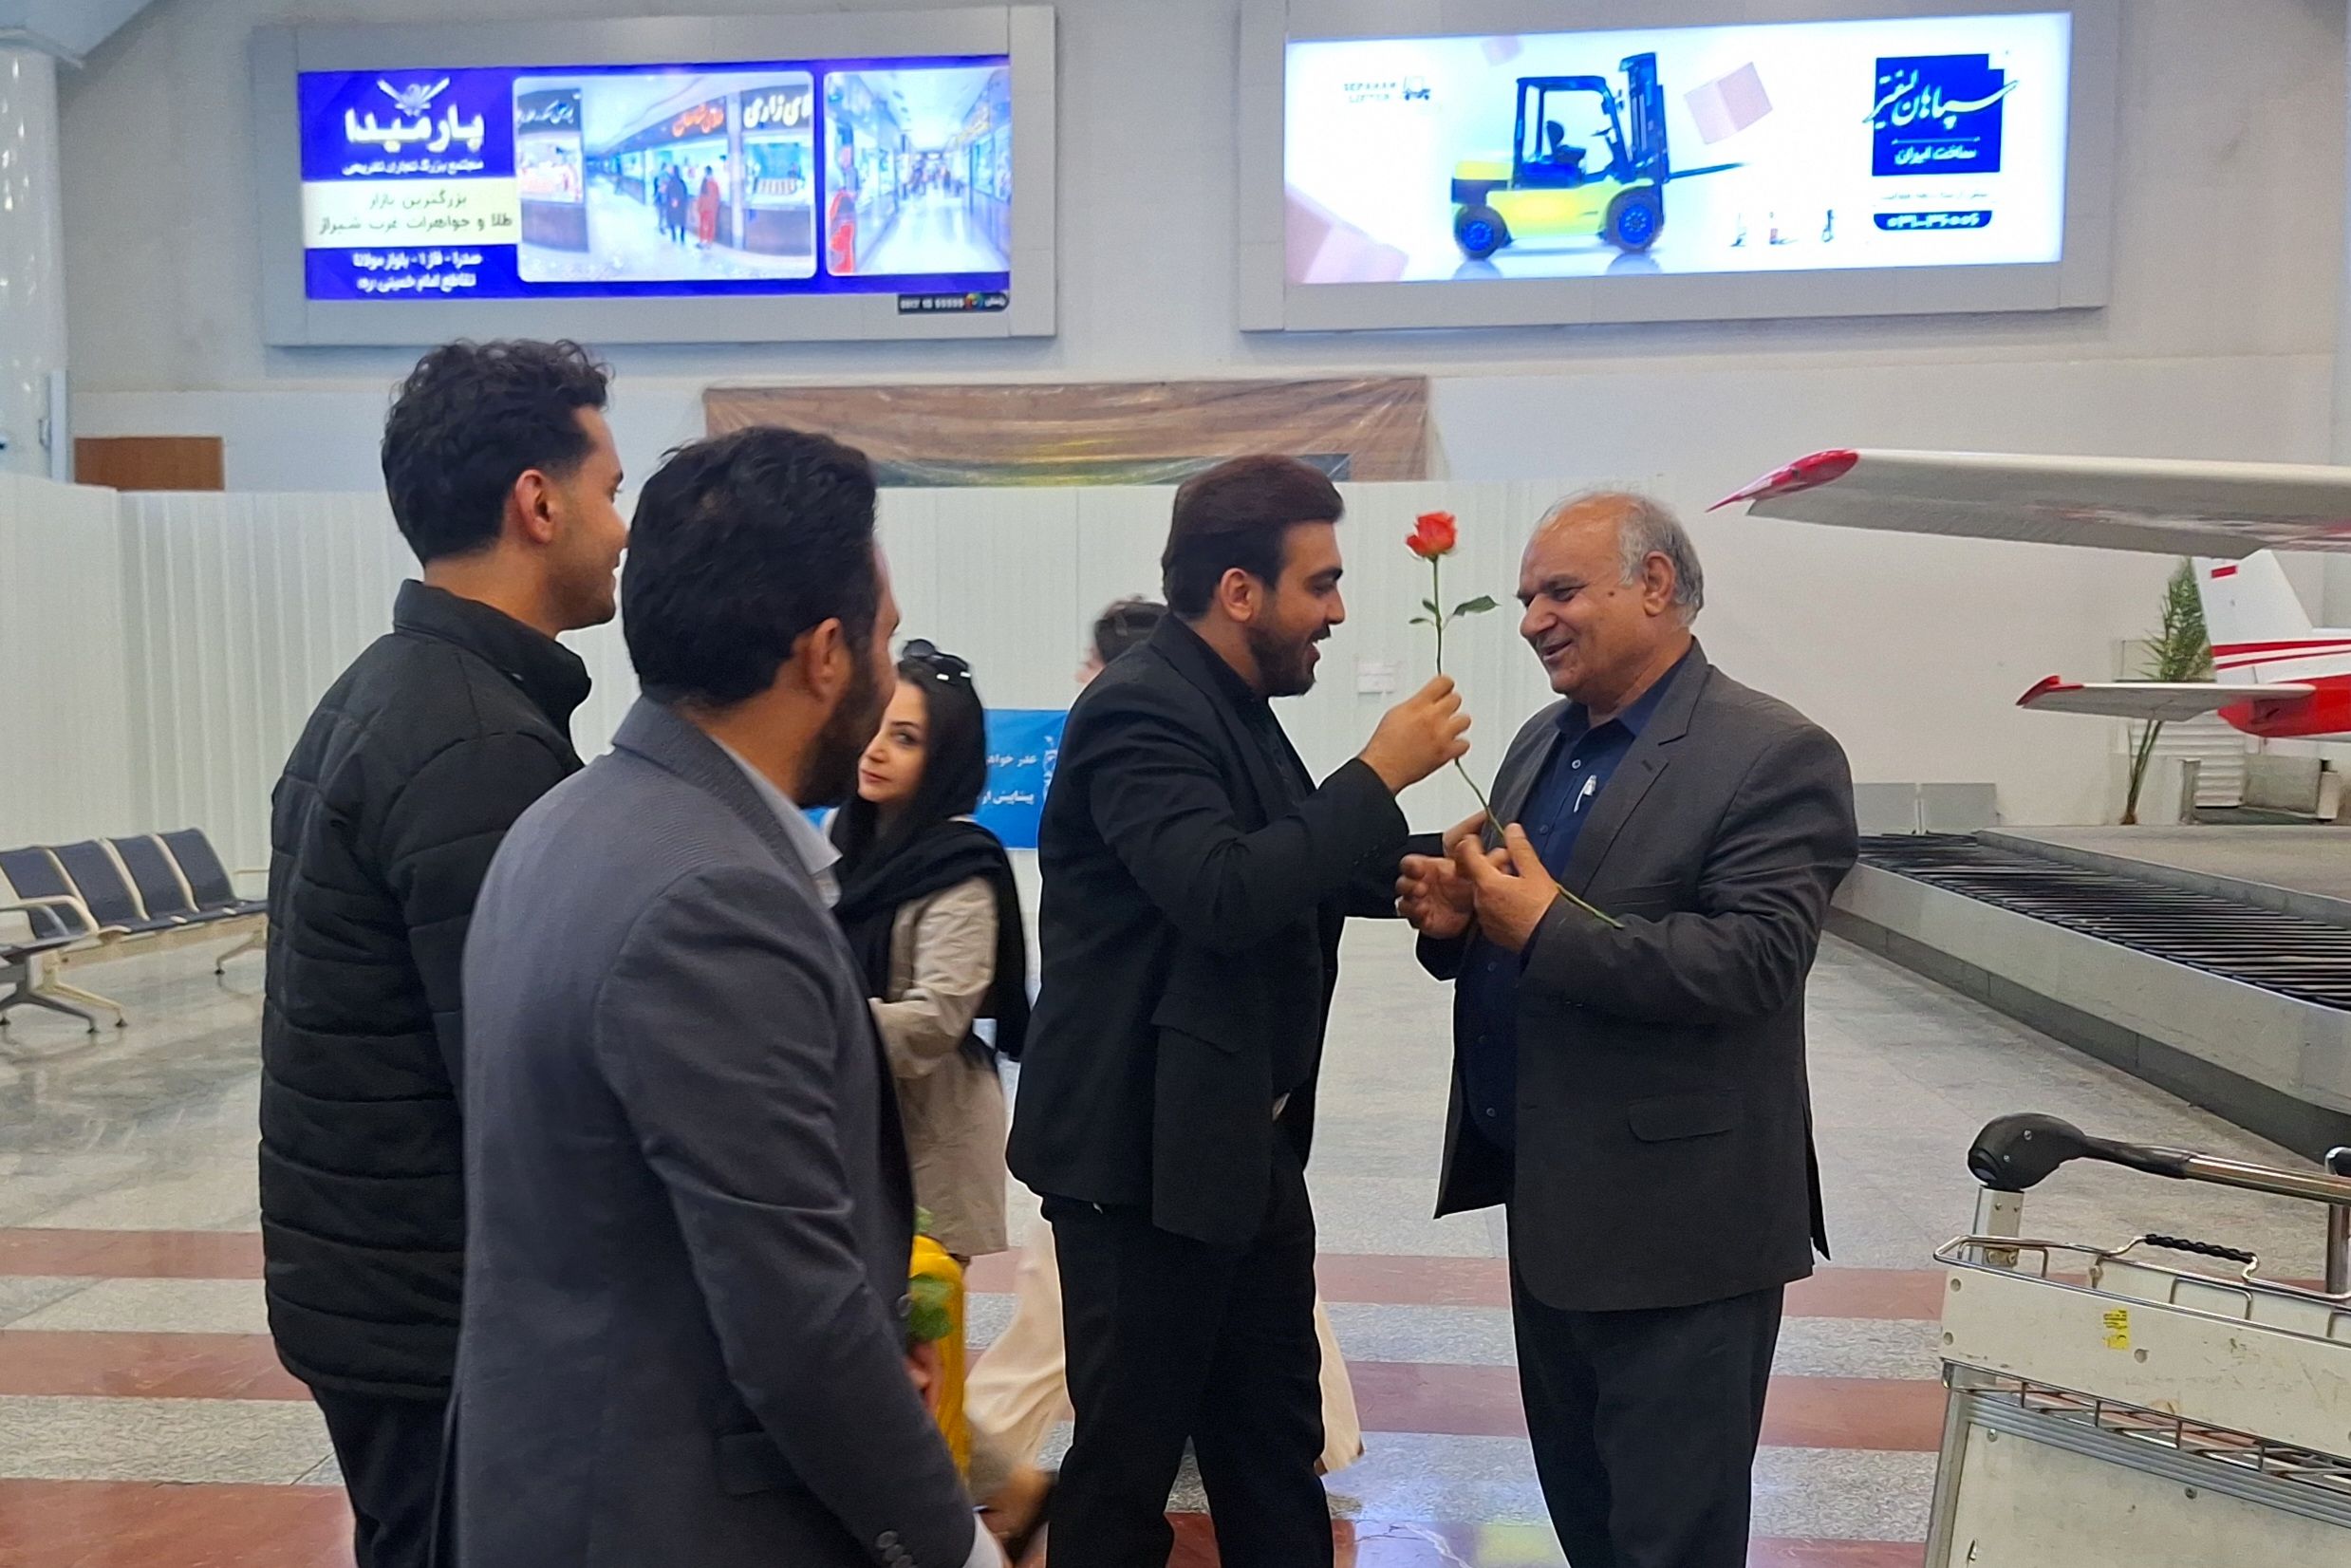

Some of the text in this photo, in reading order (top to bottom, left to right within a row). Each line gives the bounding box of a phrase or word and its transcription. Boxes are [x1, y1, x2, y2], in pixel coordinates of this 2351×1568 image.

[369, 193, 395, 211] بازار
[319, 216, 362, 235] شیراز
[406, 215, 472, 233] جواهرات
[476, 216, 486, 232] و
[490, 213, 513, 228] طلا
